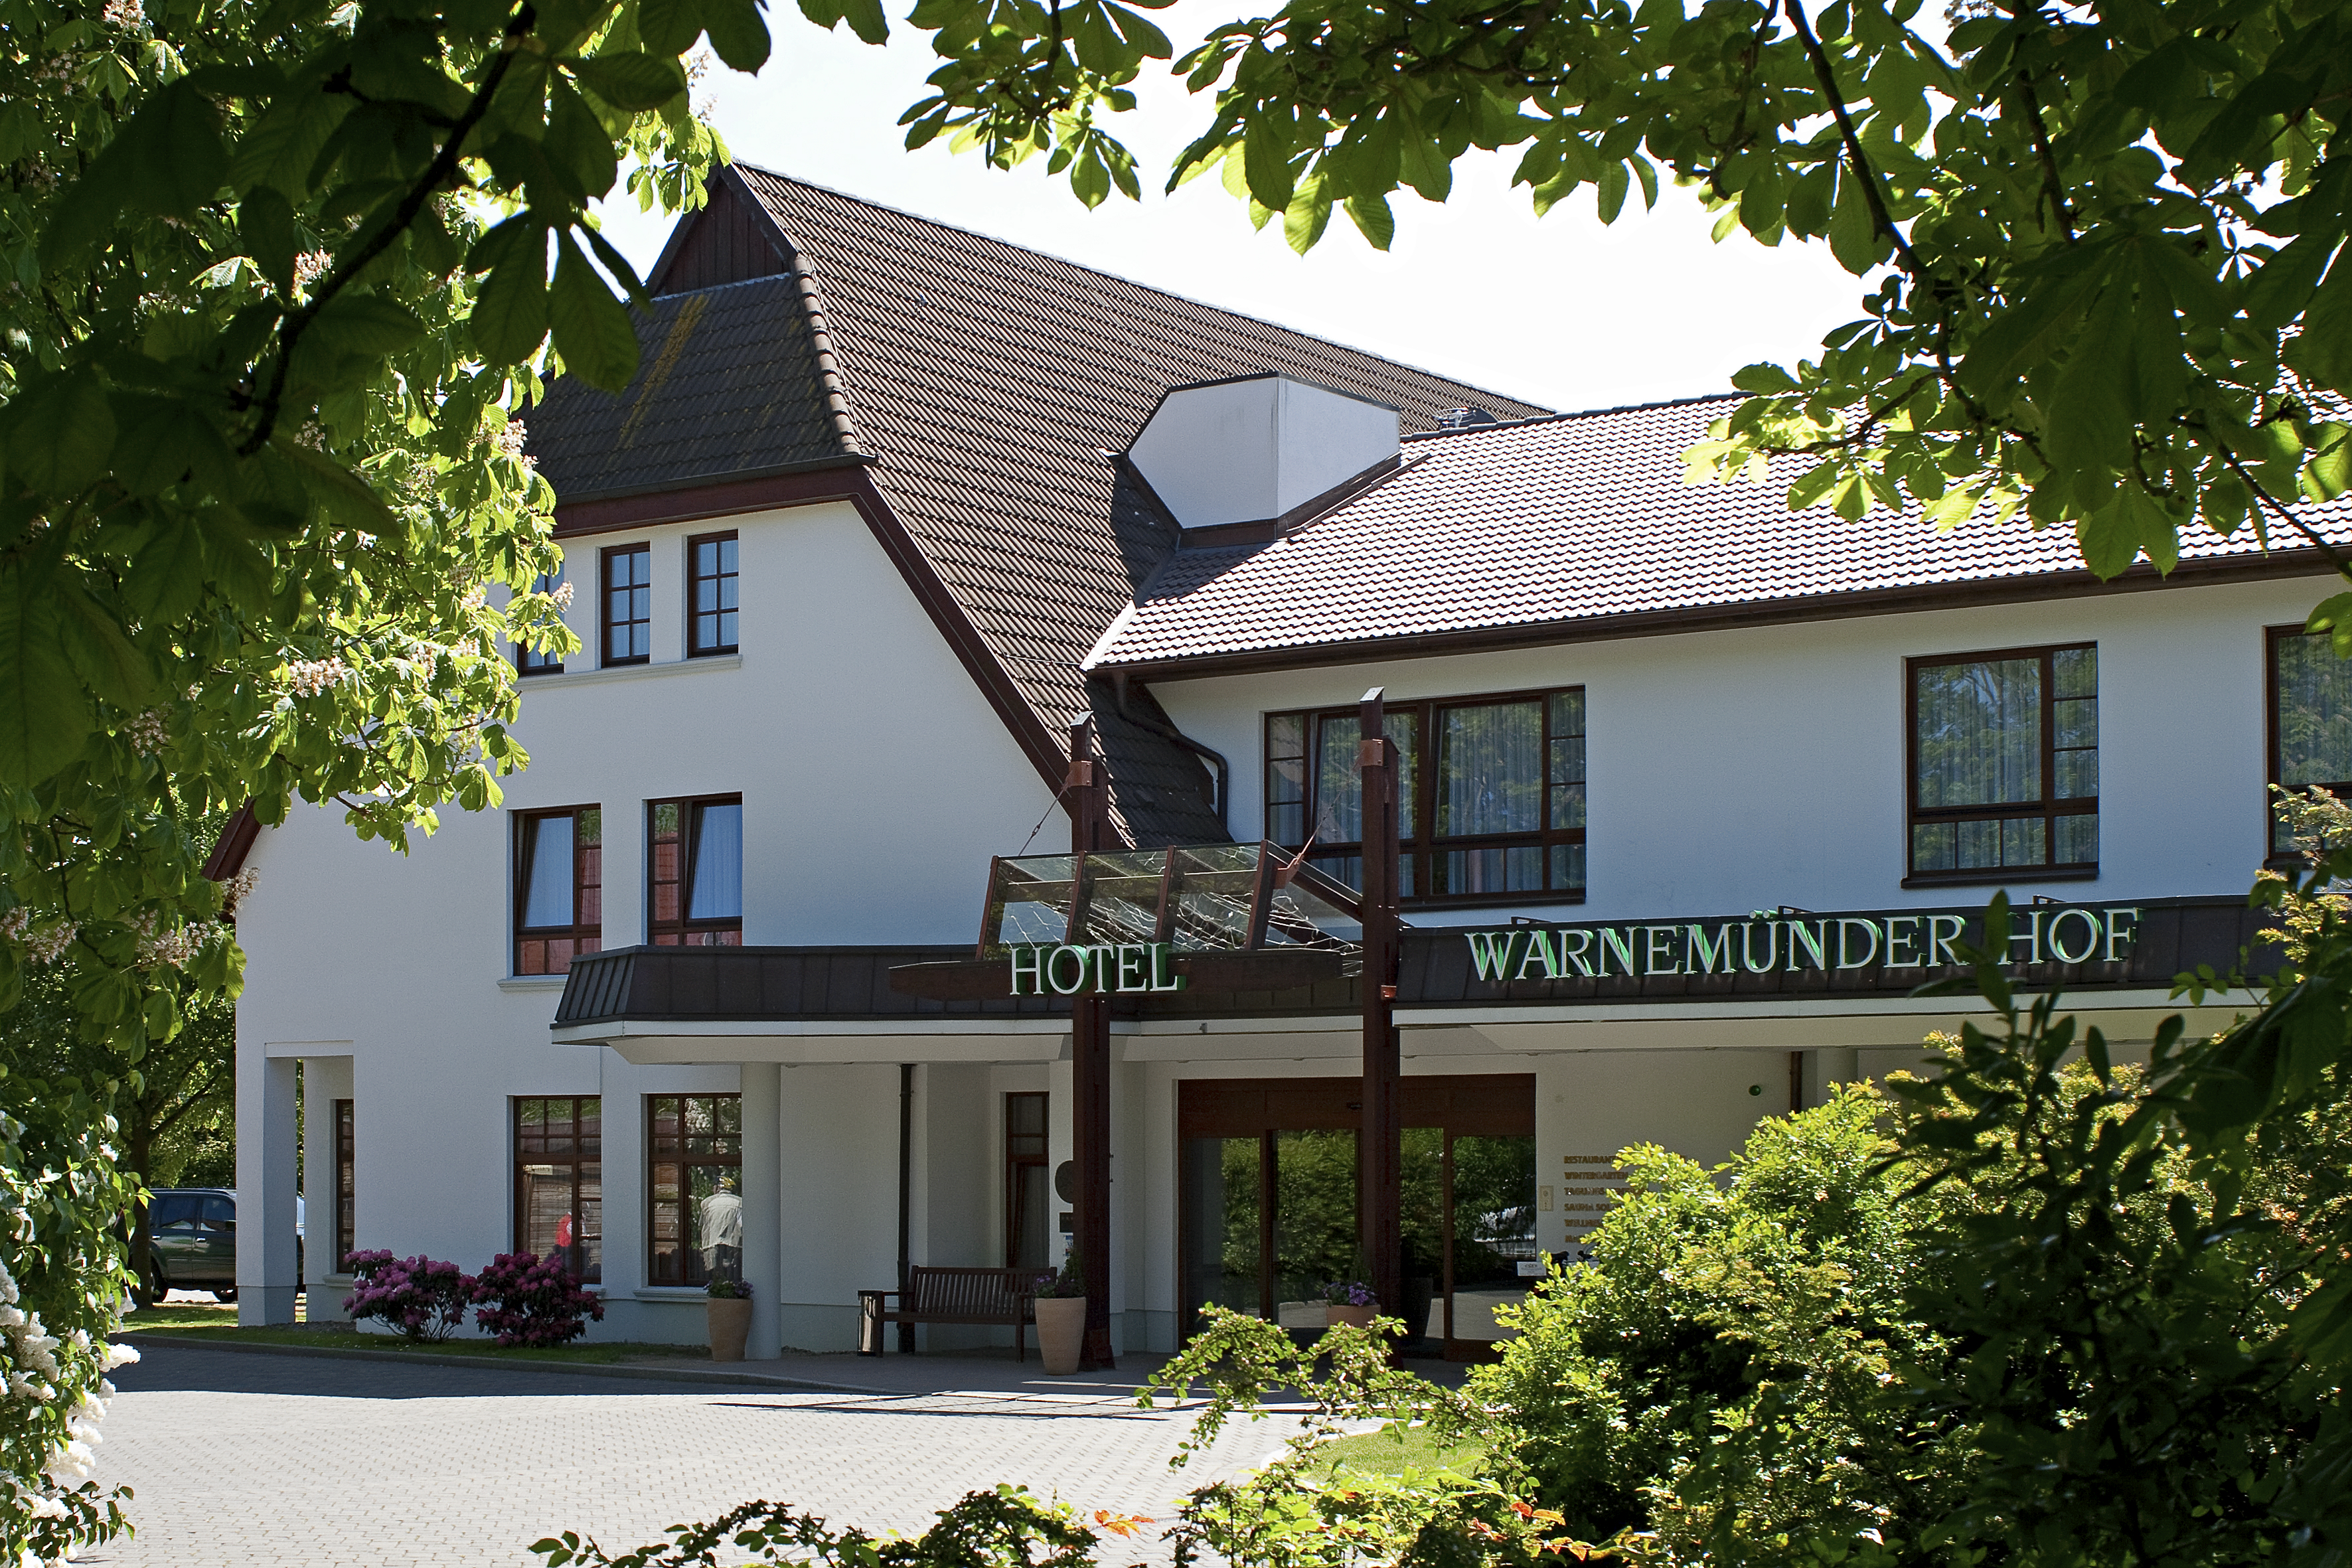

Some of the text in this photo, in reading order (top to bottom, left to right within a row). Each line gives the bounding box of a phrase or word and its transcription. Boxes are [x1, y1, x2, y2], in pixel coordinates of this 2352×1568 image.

[1010, 943, 1182, 994] HOTEL
[1464, 907, 2141, 981] WARNEMÜNDER HOF
